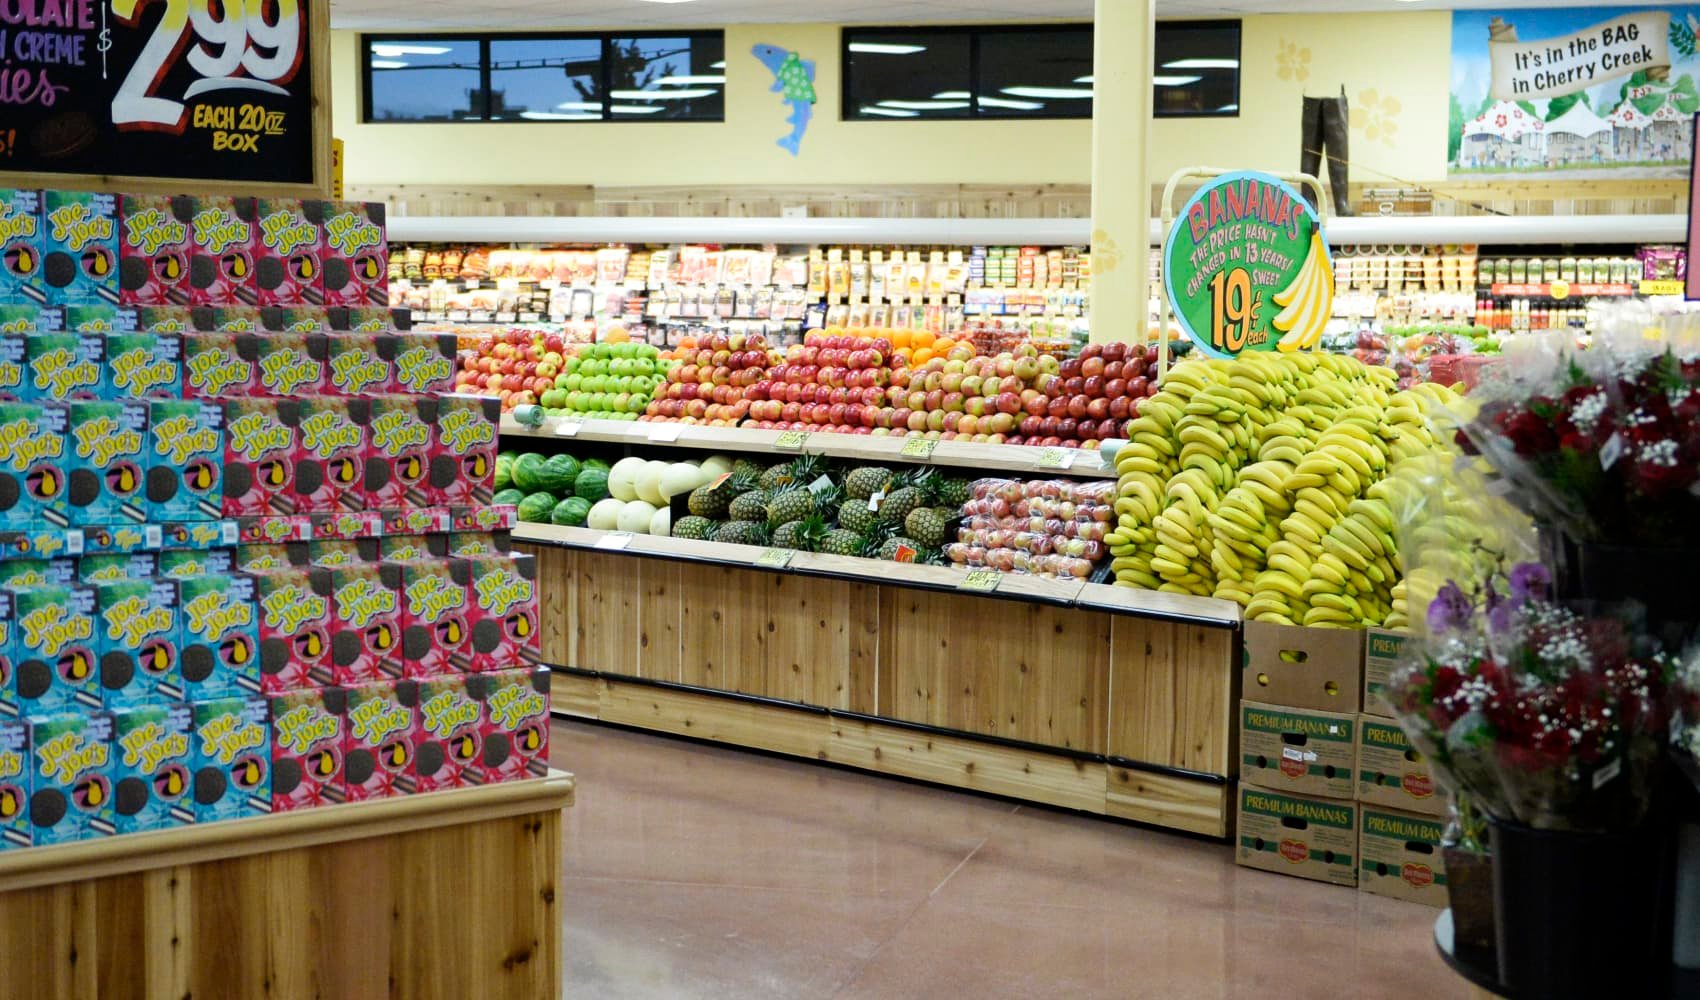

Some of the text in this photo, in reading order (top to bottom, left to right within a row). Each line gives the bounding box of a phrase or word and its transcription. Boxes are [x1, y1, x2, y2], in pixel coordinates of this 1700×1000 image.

[14, 31, 86, 66] CREME
[1514, 22, 1640, 71] It's in the BAG
[1512, 45, 1653, 94] in Cherry Creek
[193, 104, 235, 130] EACH
[239, 104, 266, 132] 20
[213, 131, 260, 152] BOX
[1188, 177, 1304, 245] BANANAS
[1190, 223, 1277, 270] THE PRICE HASN'T
[1187, 243, 1294, 298] CHANGED IN 13 YEARS!
[1252, 269, 1280, 287] SWEET
[1248, 712, 1348, 737] PREMIUM BANANS
[1246, 795, 1348, 825] PREMIUM BANANAS
[1368, 816, 1418, 837] PREMIUM
